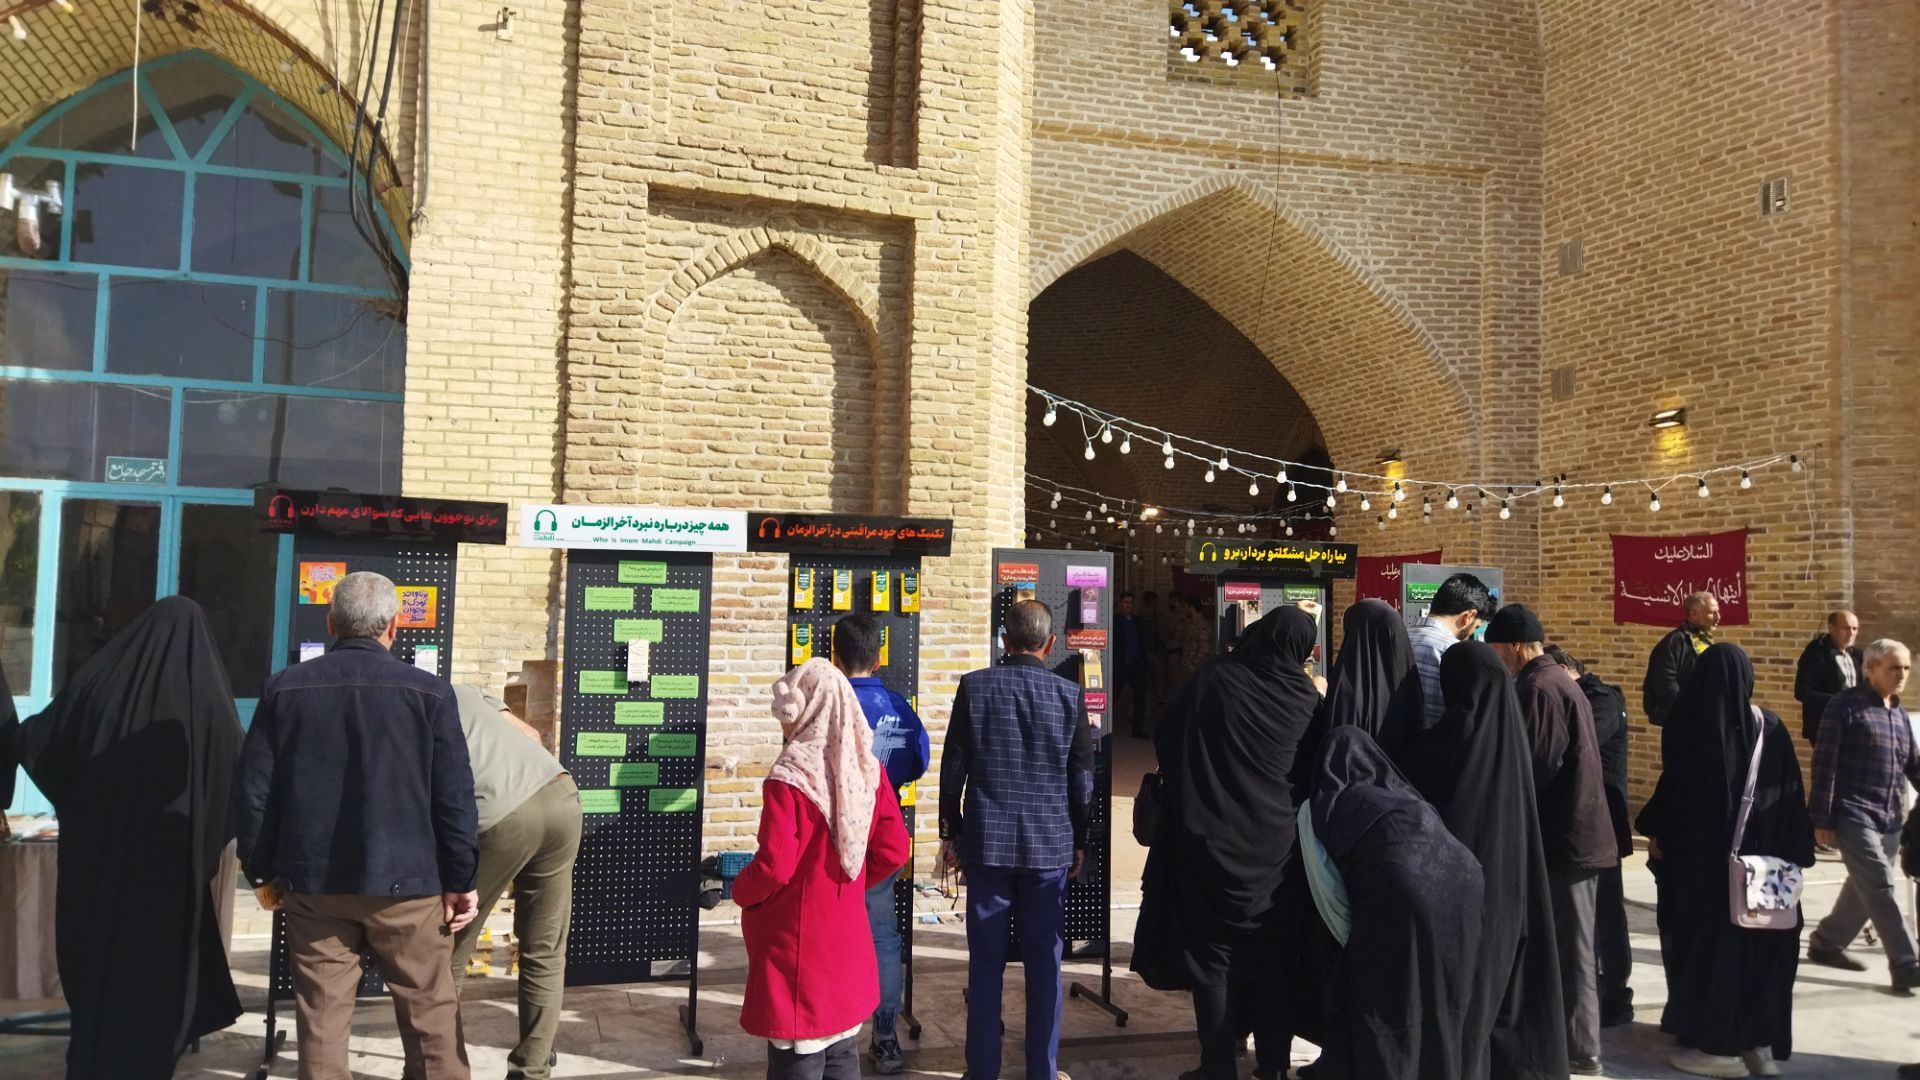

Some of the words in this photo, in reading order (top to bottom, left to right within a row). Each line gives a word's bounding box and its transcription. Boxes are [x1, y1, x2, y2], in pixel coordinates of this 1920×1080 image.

[300, 504, 326, 517] دارن
[326, 506, 349, 517] مهم
[350, 505, 389, 519] سوالای
[390, 508, 403, 519] که
[476, 513, 498, 526] برای
[571, 515, 633, 530] آخرالزمان
[632, 516, 654, 531] نبرد
[654, 518, 690, 532] درباره
[689, 520, 708, 535] چیز
[707, 523, 730, 532] همه
[786, 522, 831, 537] آخرالزمان
[841, 525, 876, 539] مراقبتی
[877, 527, 897, 539] خود
[897, 527, 915, 540] های
[916, 527, 945, 539] تکنیک
[1267, 545, 1306, 562] مشکلتو
[1305, 548, 1321, 563] حل
[1334, 548, 1347, 564] بیا
